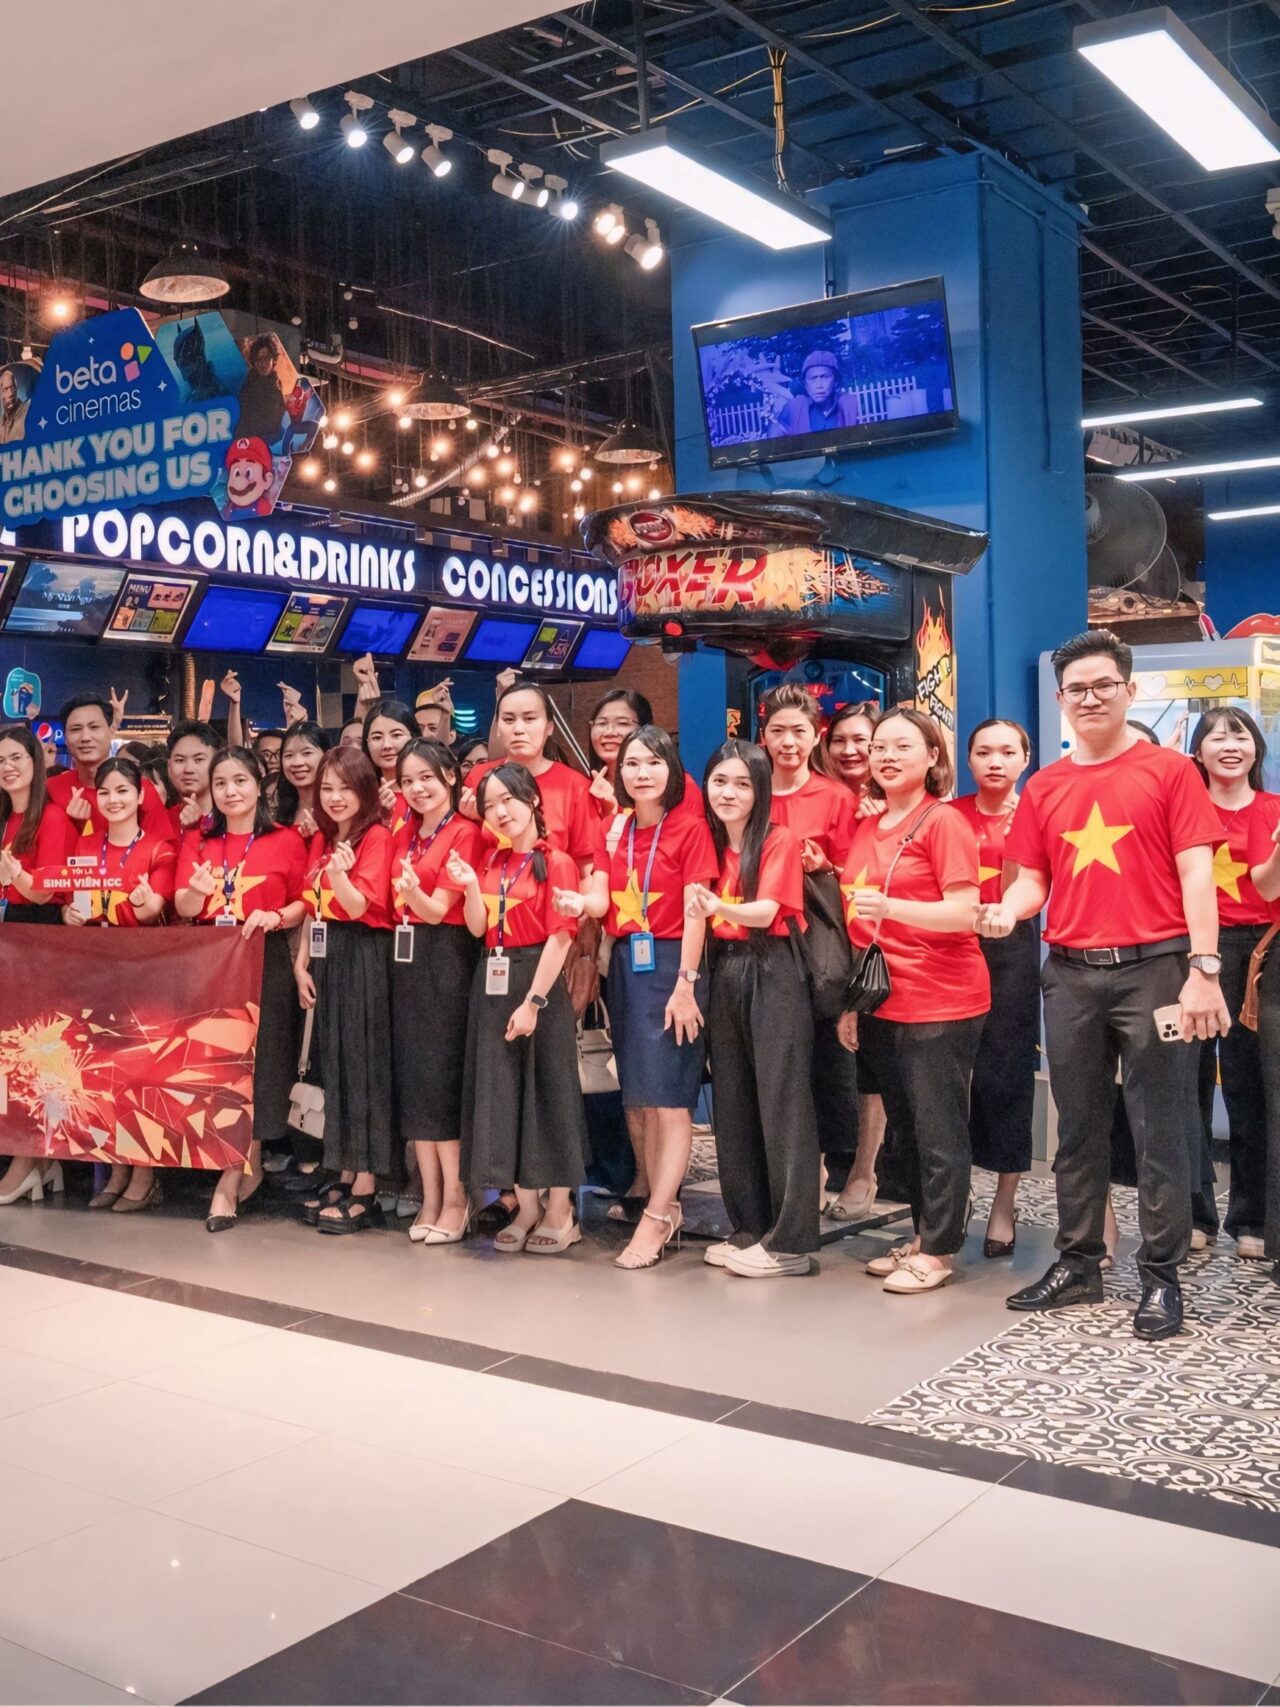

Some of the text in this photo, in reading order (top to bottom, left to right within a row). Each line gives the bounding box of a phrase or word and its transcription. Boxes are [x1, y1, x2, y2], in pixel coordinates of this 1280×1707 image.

[56, 356, 116, 394] beta
[56, 390, 141, 425] cinemas
[88, 422, 155, 464] YOU
[162, 408, 233, 451] FOR
[3, 452, 212, 519] CHOOSING US
[129, 583, 151, 594] MENU
[442, 556, 618, 615] CONCESSIONS
[43, 876, 122, 888] SINH VIÊN ICC
